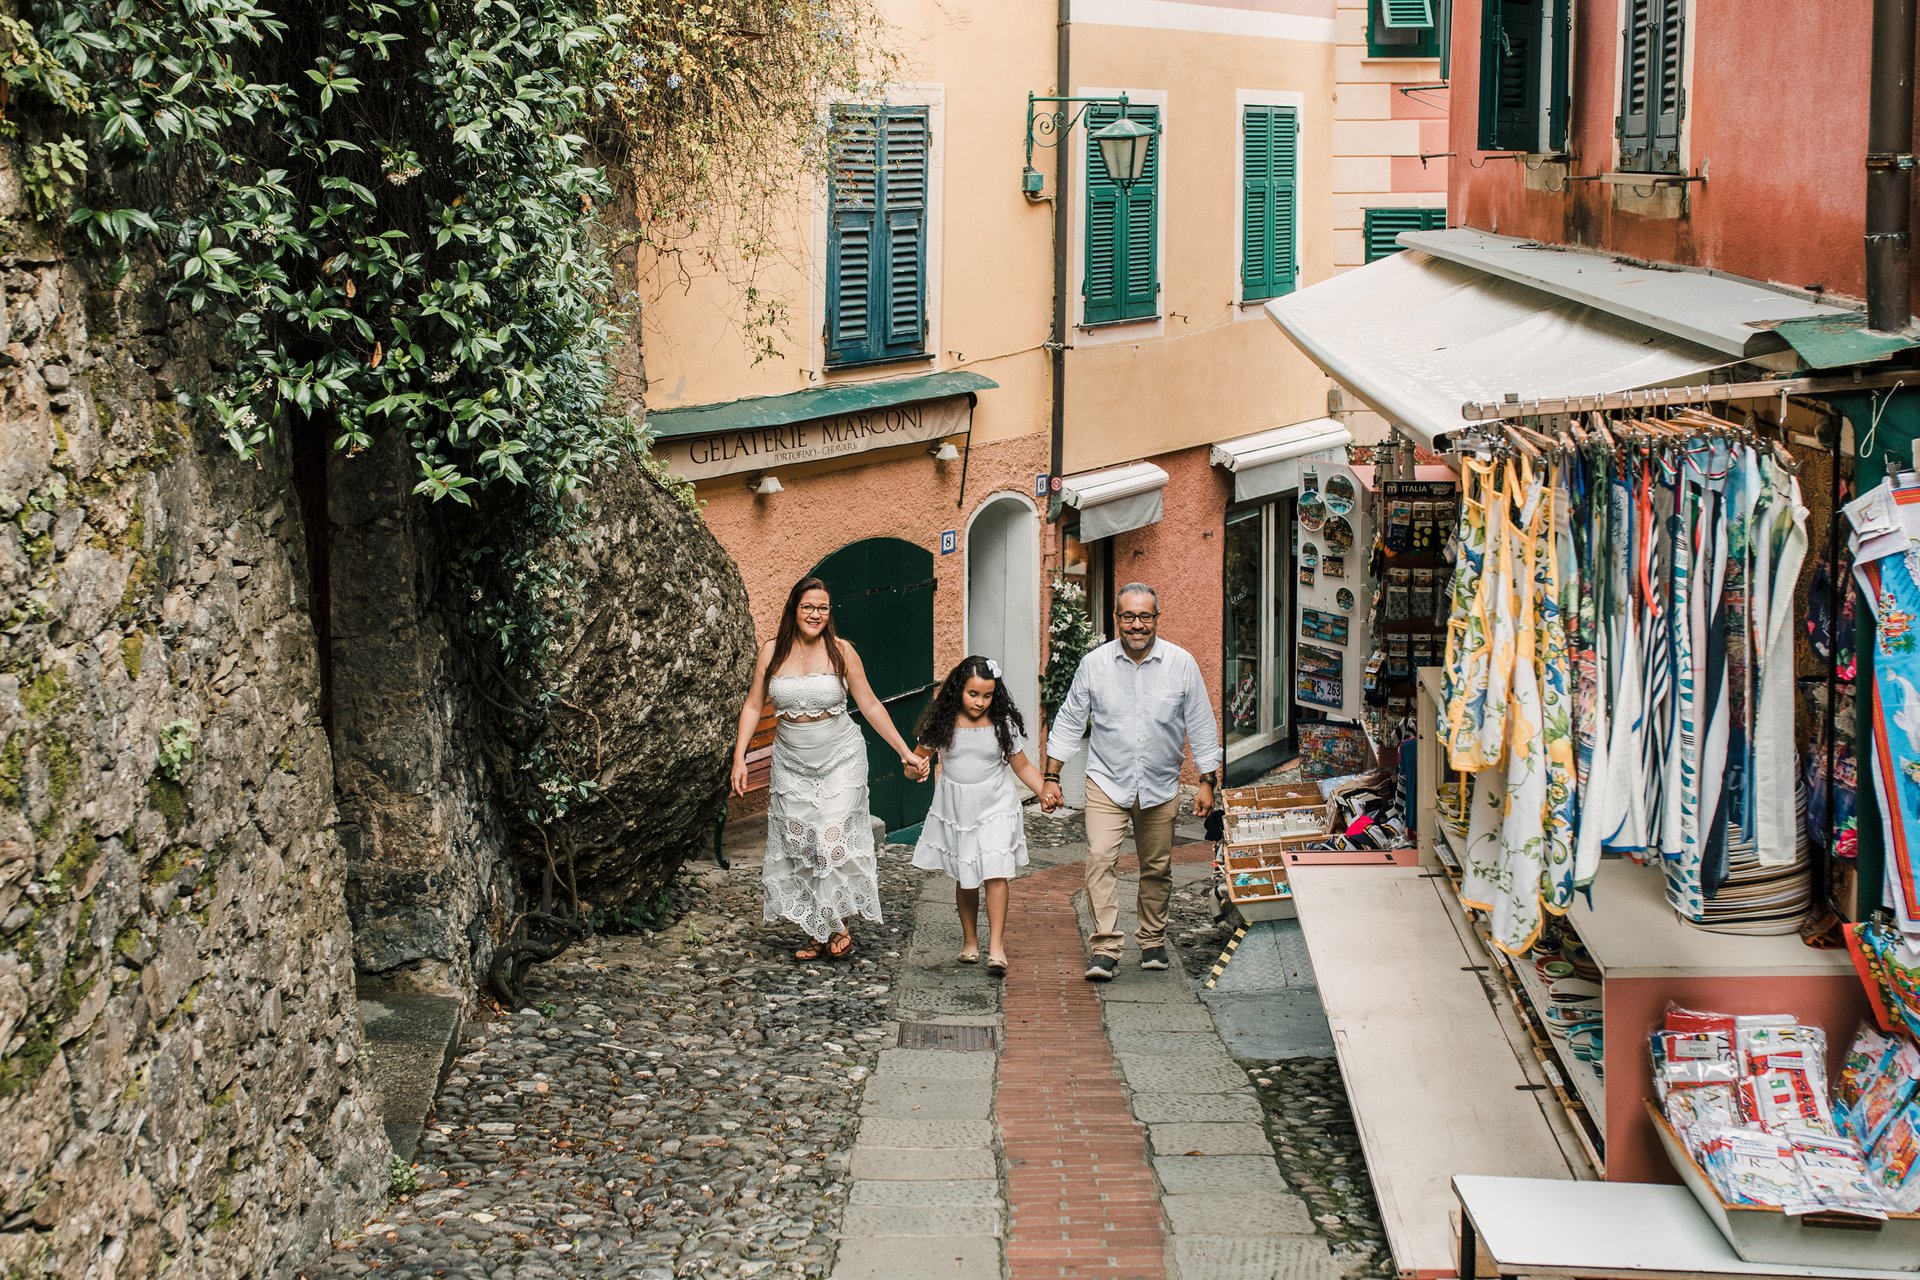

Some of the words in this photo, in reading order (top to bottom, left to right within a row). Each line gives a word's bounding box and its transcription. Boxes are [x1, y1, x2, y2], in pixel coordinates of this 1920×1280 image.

[689, 425, 808, 465] GELATERIE
[822, 407, 923, 444] MARCONI
[774, 448, 817, 463] PORTOFINO
[1039, 480, 1045, 490] 6
[1401, 485, 1428, 493] ITALIA
[945, 536, 952, 548] 8
[1327, 682, 1341, 697] 263
